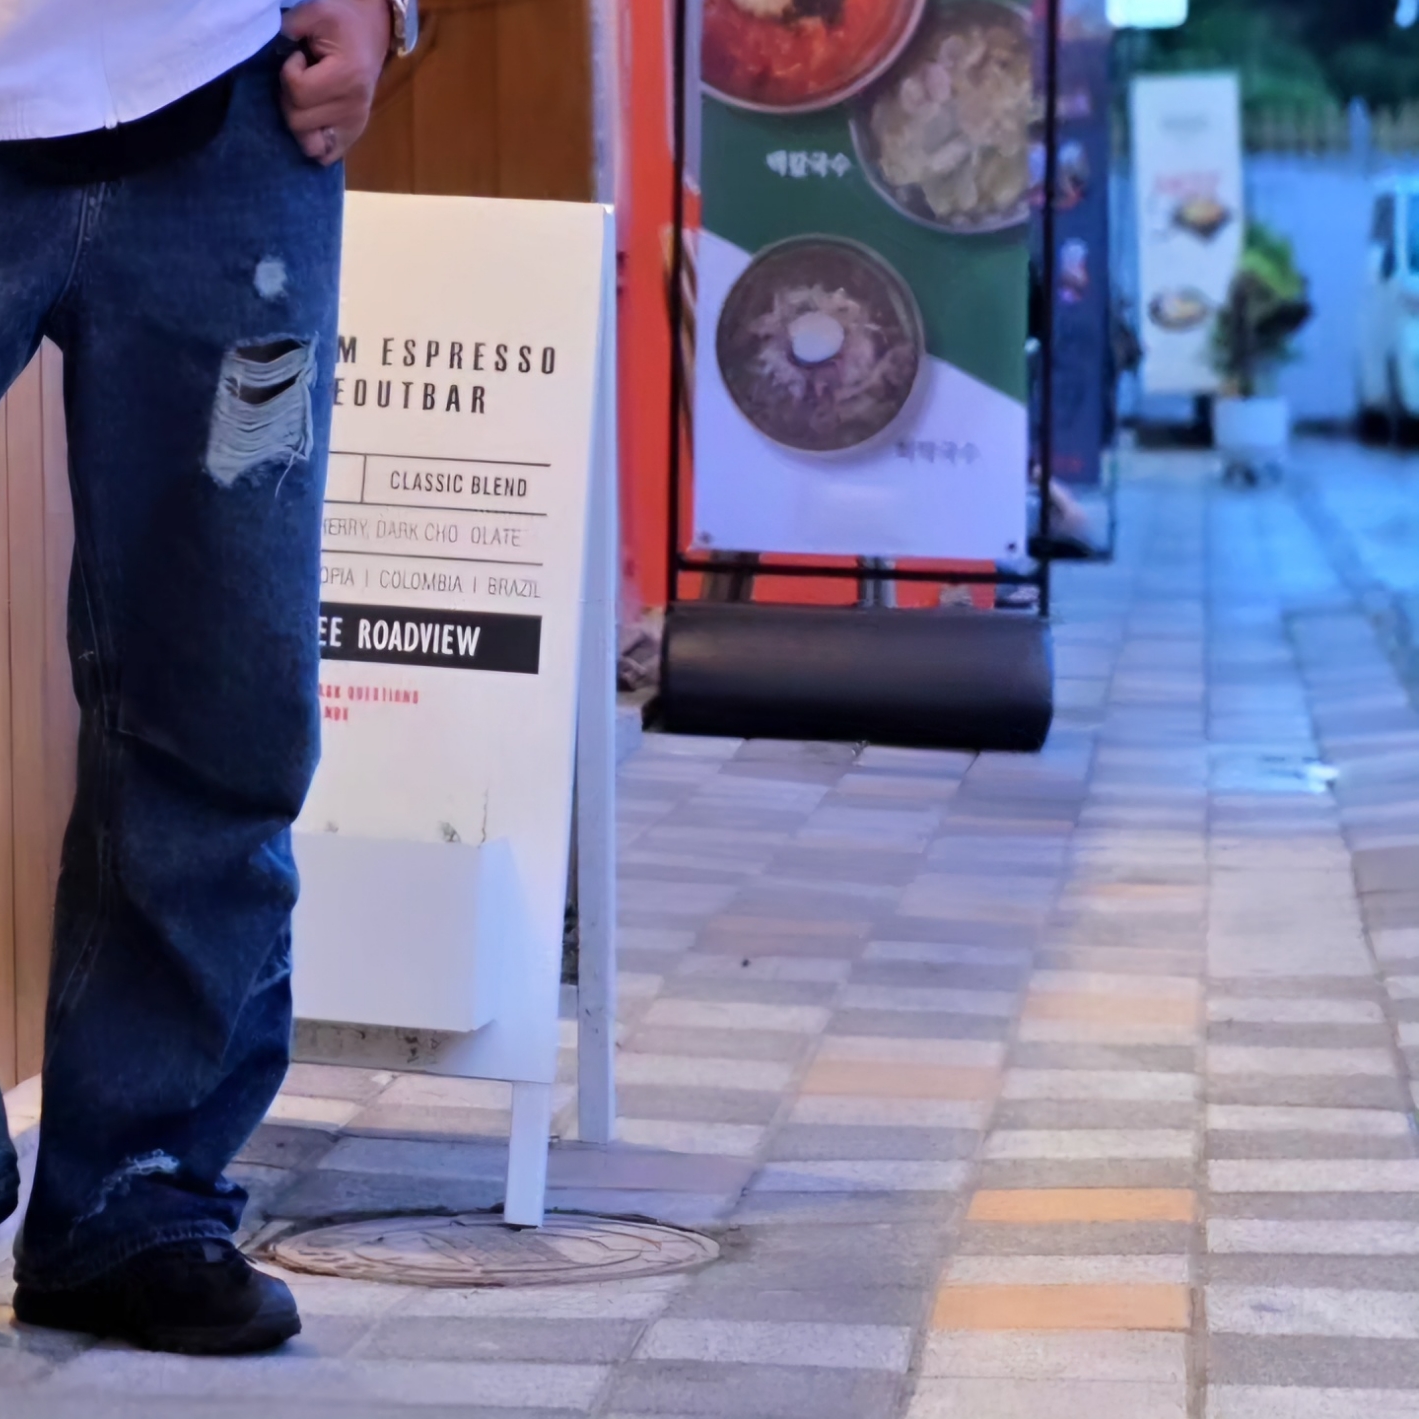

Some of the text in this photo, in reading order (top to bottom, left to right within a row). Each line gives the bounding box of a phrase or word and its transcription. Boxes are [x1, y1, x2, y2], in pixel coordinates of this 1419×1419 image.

[381, 337, 556, 375] ESPRESSO
[390, 470, 528, 497] CLASSIC BLEND
[376, 519, 419, 541] DARK
[379, 569, 464, 594] COLOMBIA
[487, 576, 542, 599] BRAZIL
[357, 618, 481, 657] ROADVIEW
